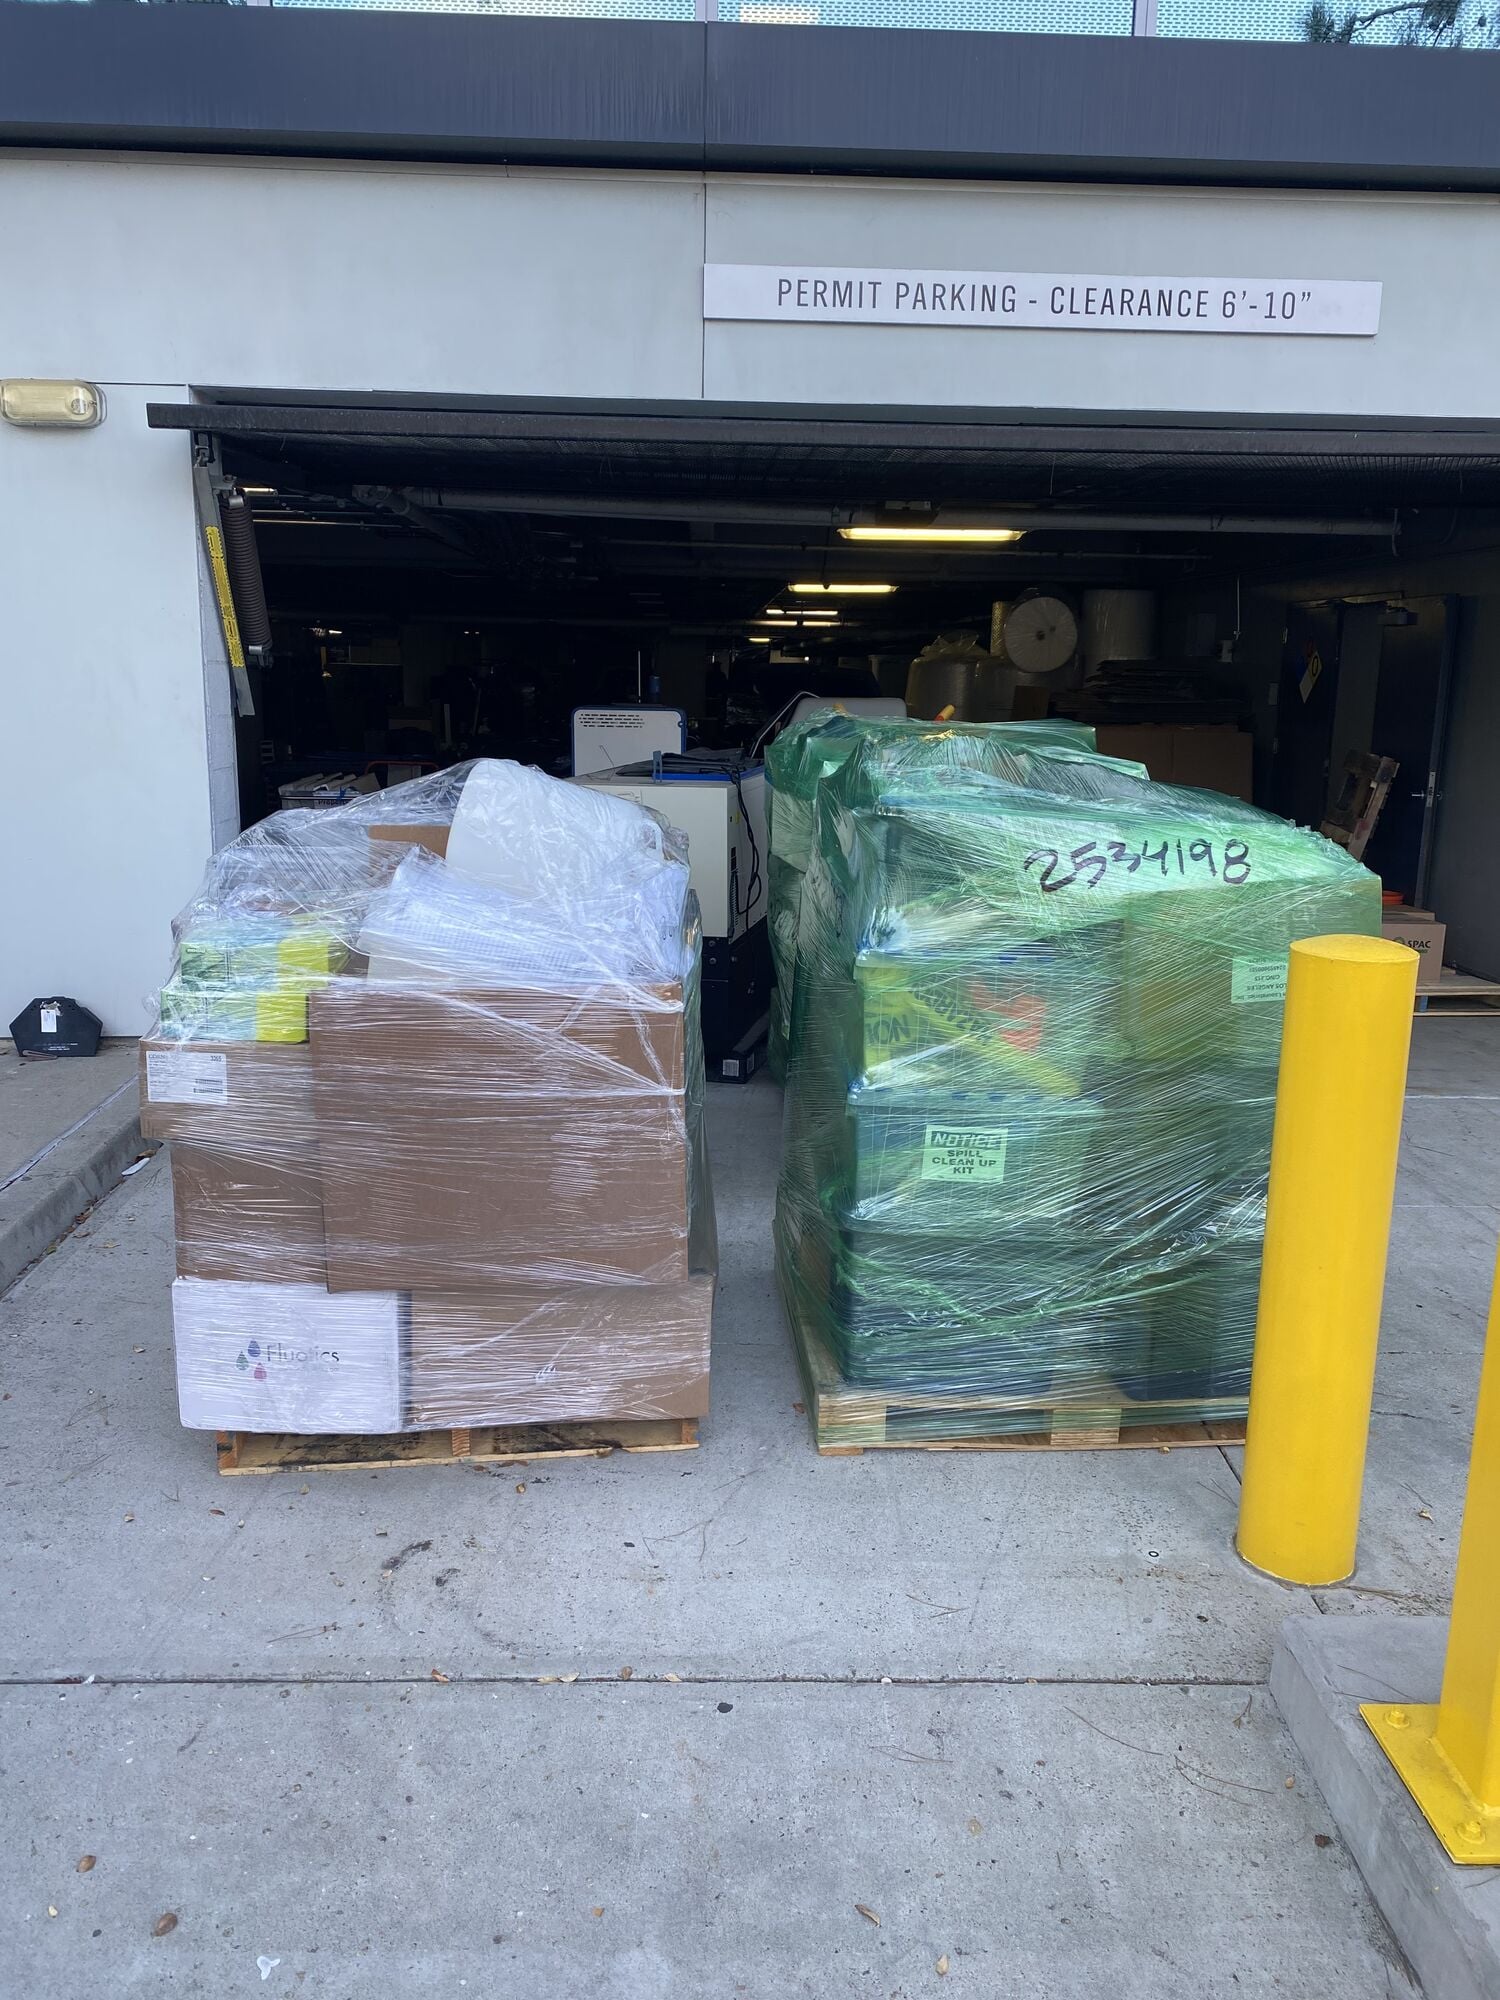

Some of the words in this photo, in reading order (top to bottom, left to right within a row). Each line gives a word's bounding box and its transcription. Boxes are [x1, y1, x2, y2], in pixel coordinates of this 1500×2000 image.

[778, 278, 882, 309] PERMIT
[895, 282, 1016, 313] PARKING
[1050, 286, 1209, 318] CLEARANCE
[1023, 838, 1251, 892] 2534198
[1407, 940, 1431, 949] SPAC
[934, 1132, 998, 1148] NOTICE
[947, 1150, 983, 1158] SPILL
[932, 1157, 974, 1166] CLEAN
[979, 1159, 997, 1167] UP
